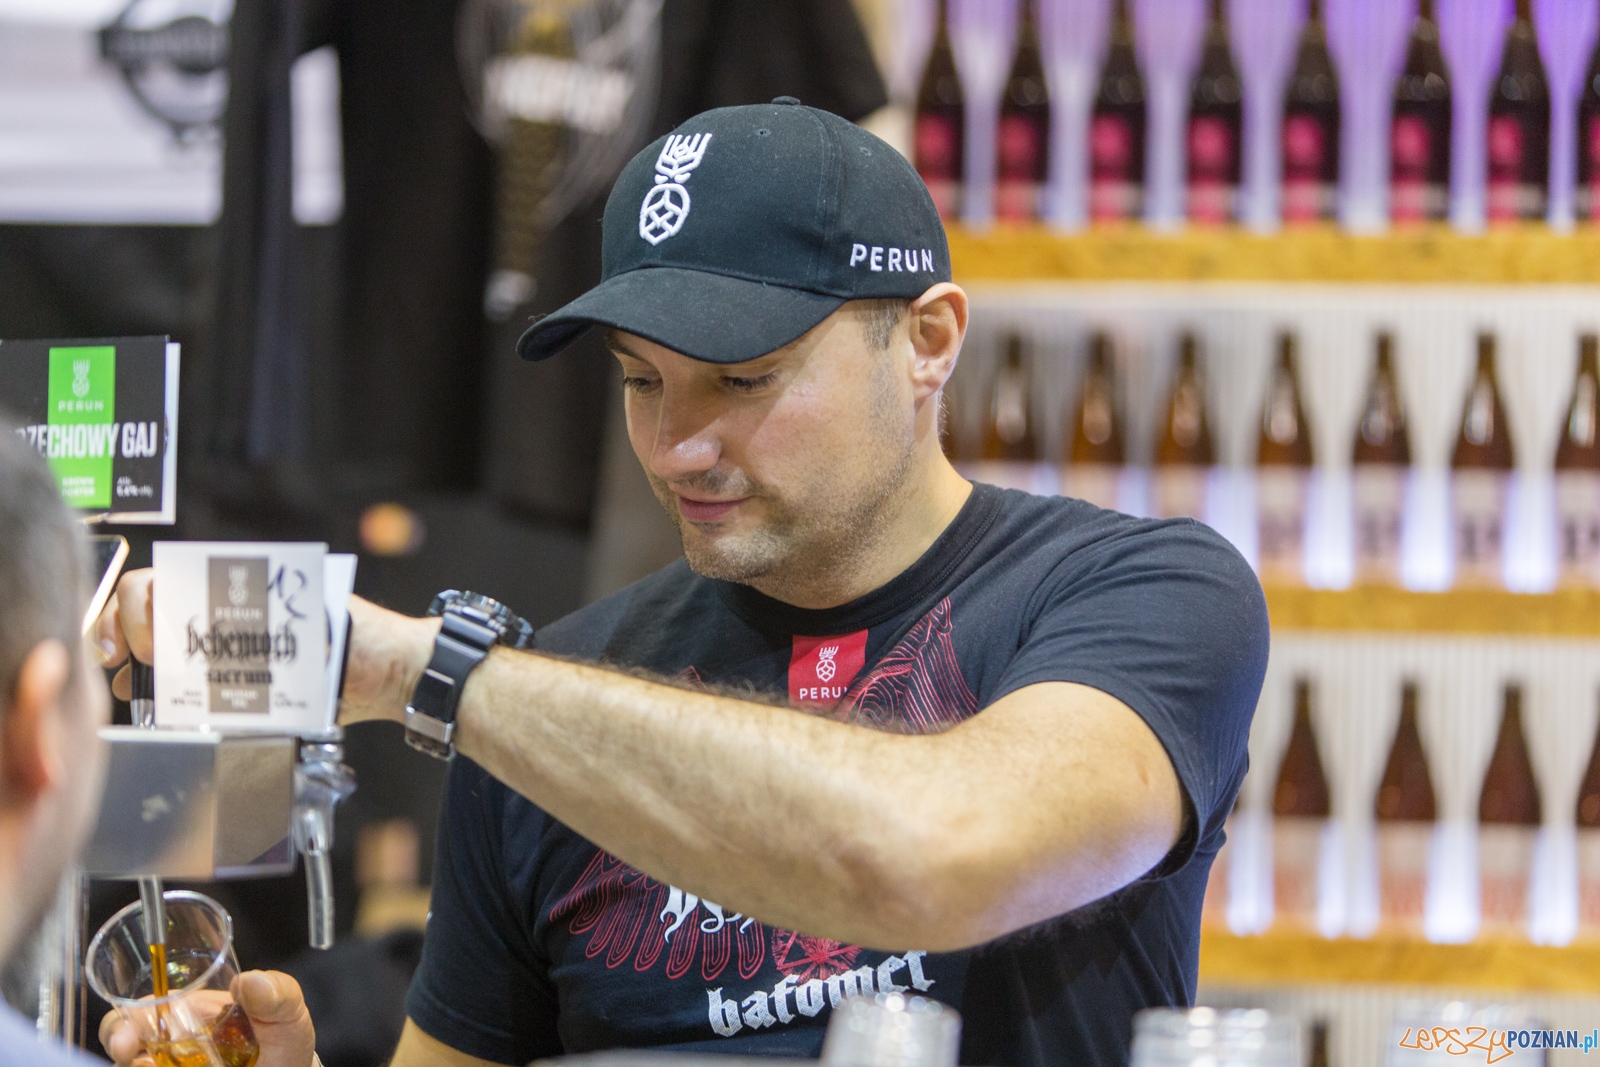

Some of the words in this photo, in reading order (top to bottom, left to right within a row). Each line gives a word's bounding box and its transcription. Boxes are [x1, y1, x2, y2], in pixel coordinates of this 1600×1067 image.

[849, 243, 935, 273] PERUN
[58, 400, 104, 413] PERUN
[122, 422, 158, 459] GAJ
[214, 606, 263, 620] PERUN
